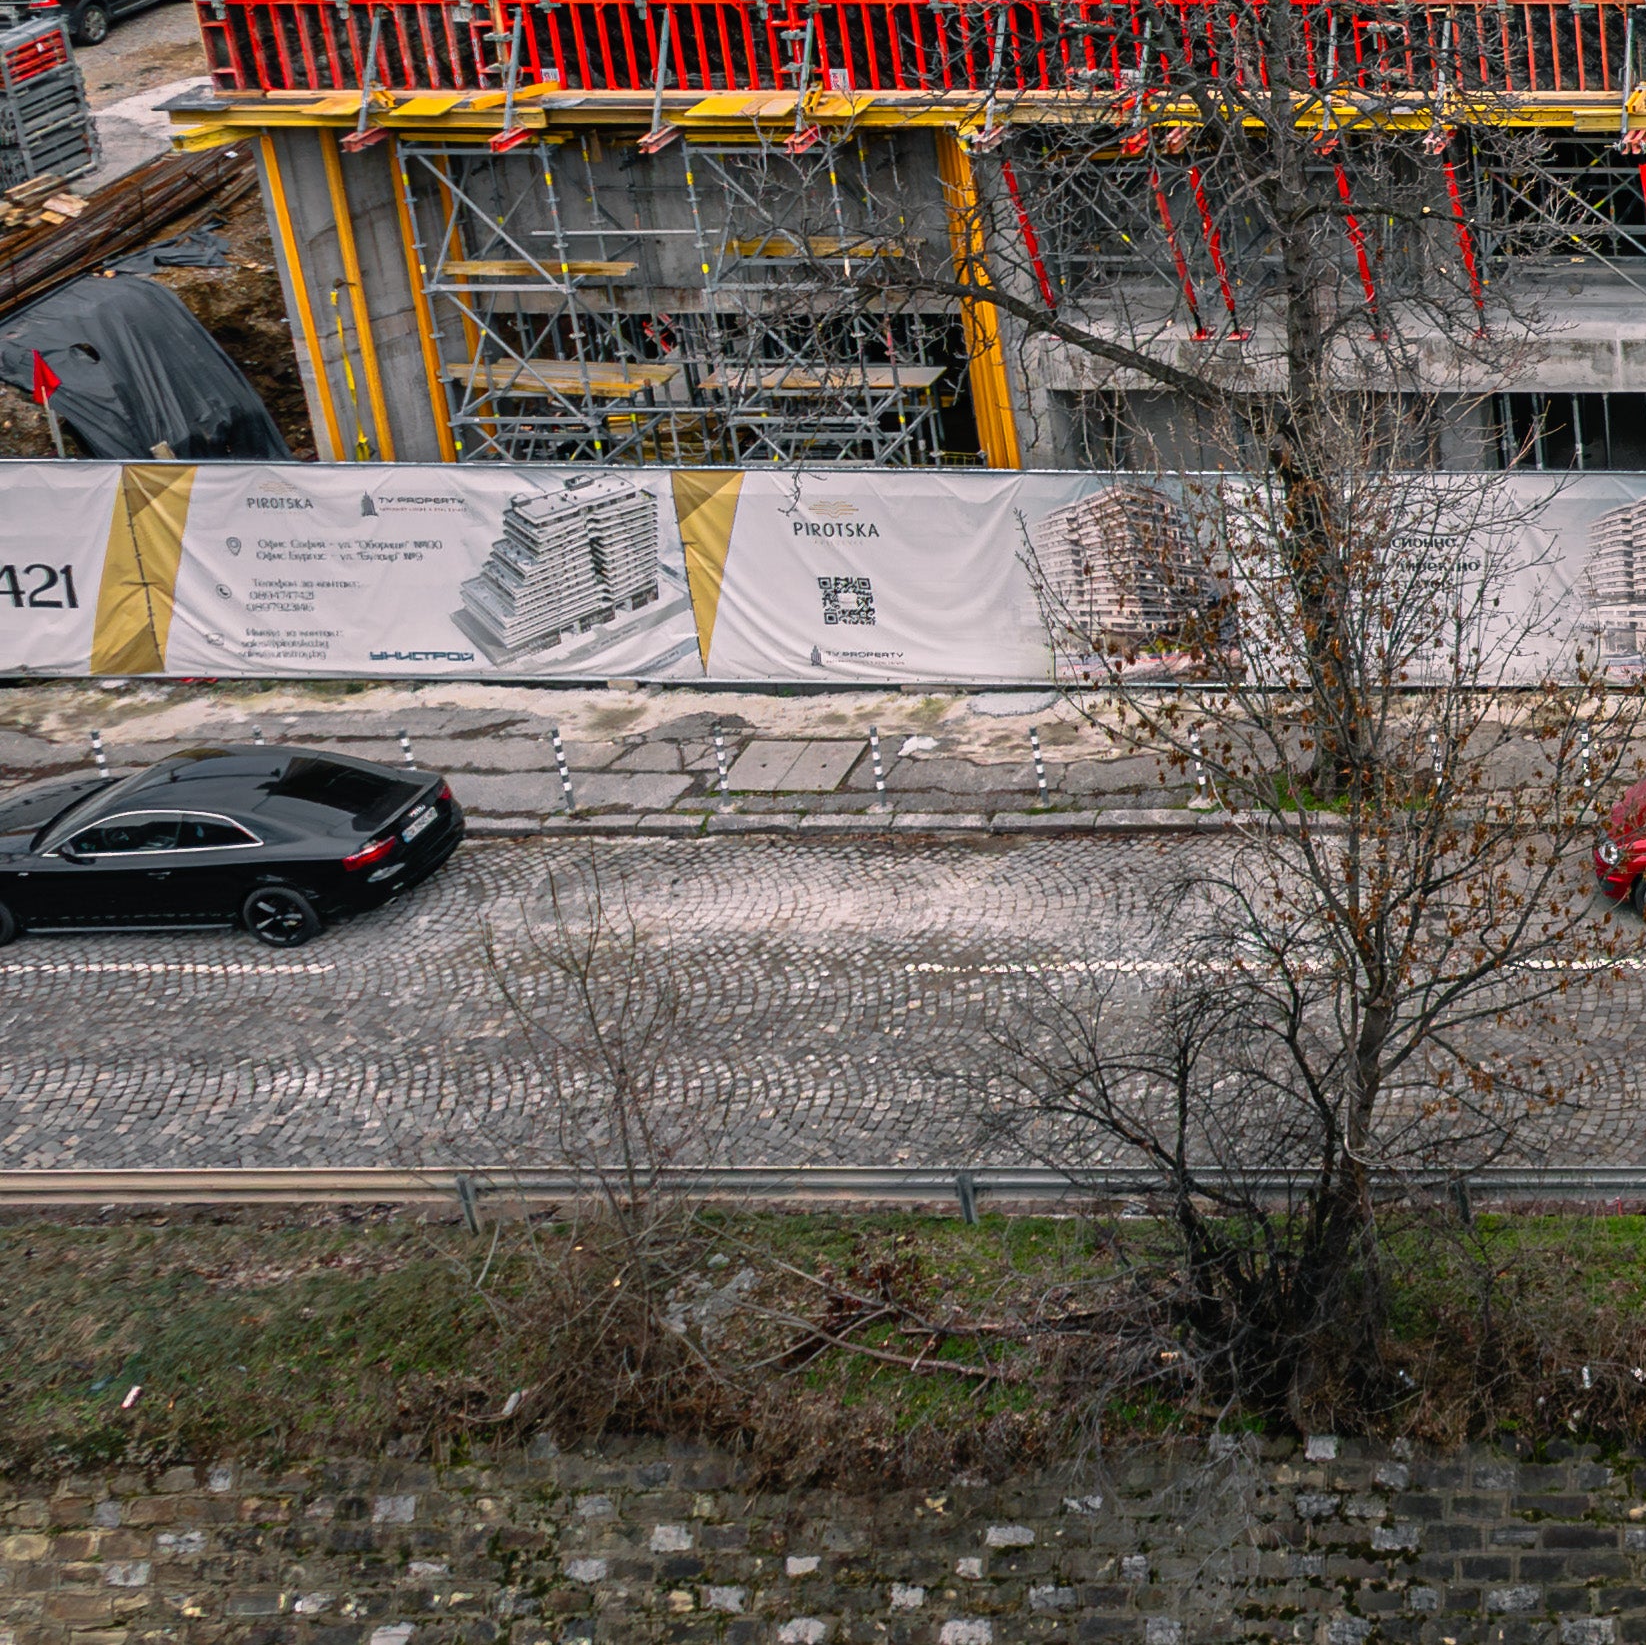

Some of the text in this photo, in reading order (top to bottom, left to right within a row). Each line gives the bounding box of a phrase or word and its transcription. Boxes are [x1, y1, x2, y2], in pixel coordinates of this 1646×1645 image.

[247, 497, 314, 510] PIROTSKA
[793, 522, 880, 537] PIROTSKA
[369, 651, 474, 662] УНИСТРОЙ
